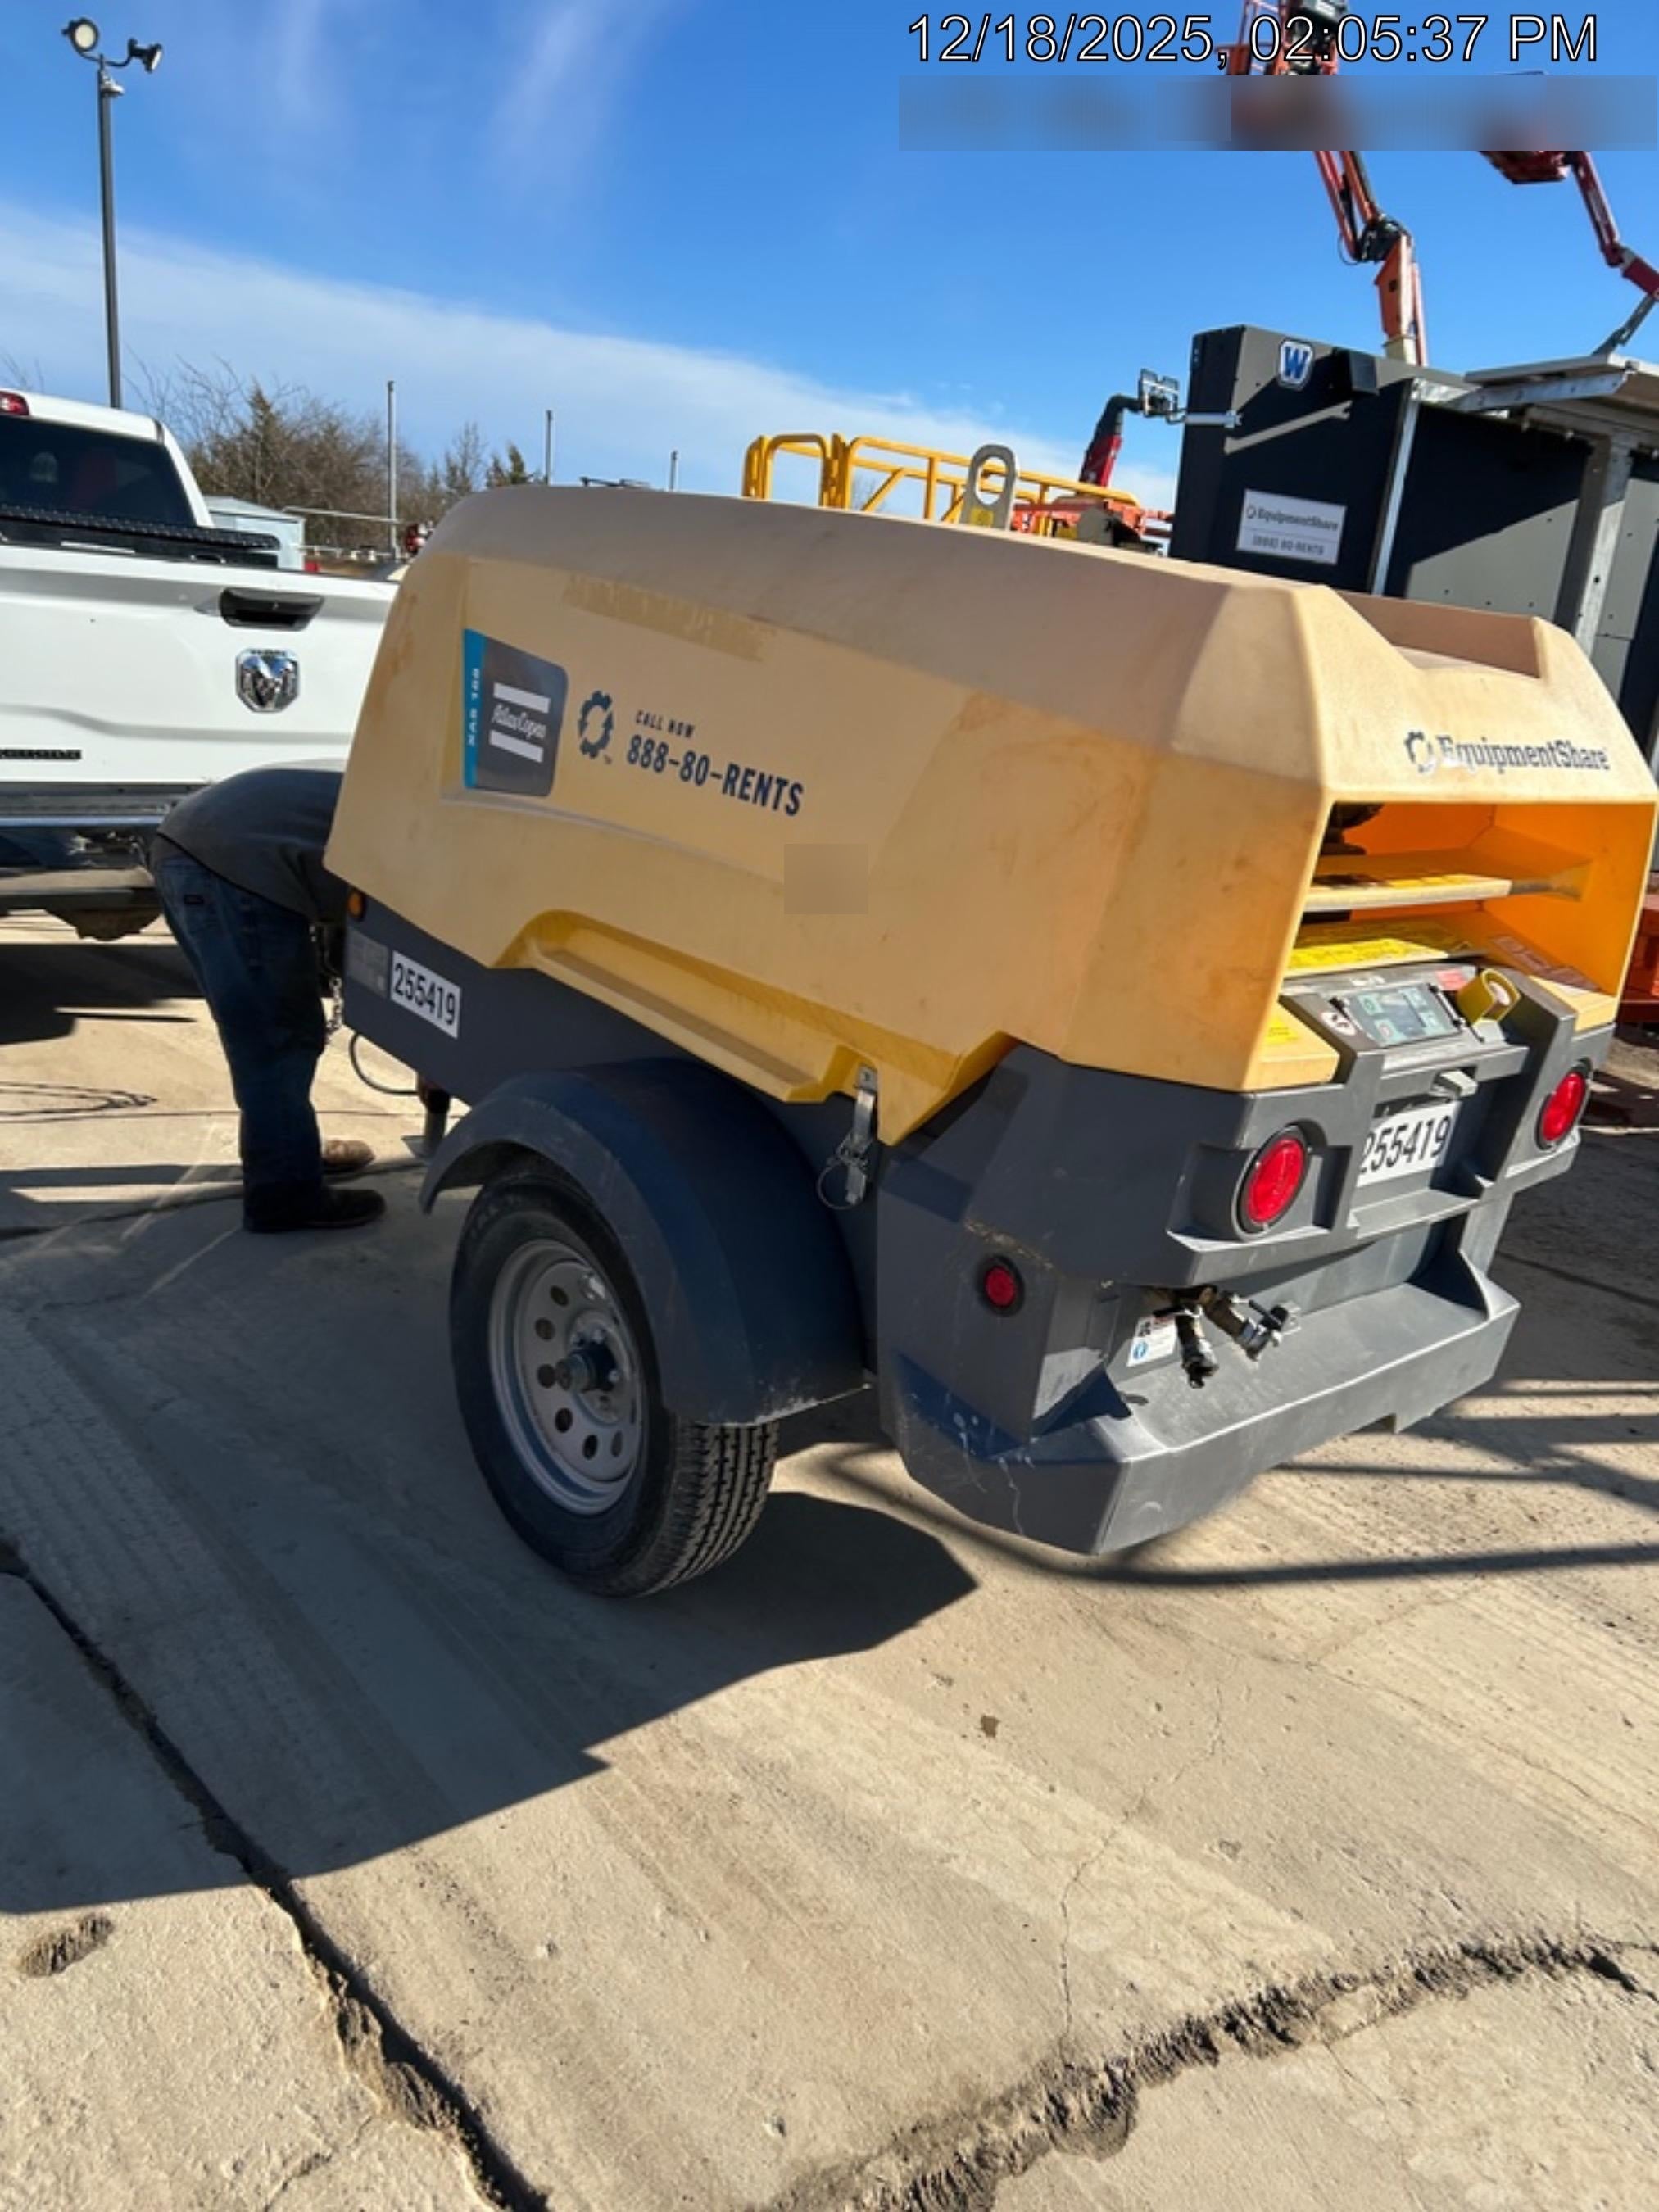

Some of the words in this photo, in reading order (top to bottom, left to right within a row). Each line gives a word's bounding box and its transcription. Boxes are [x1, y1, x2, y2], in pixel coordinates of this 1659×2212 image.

[1285, 346, 1310, 379] W
[1258, 507, 1338, 531] EquipmentShare
[635, 709, 663, 731] CALL
[668, 719, 696, 739] NOW
[1435, 735, 1611, 774] EquipmentShare
[626, 734, 804, 817] 888-80-RENTS
[394, 962, 456, 1026] 255419
